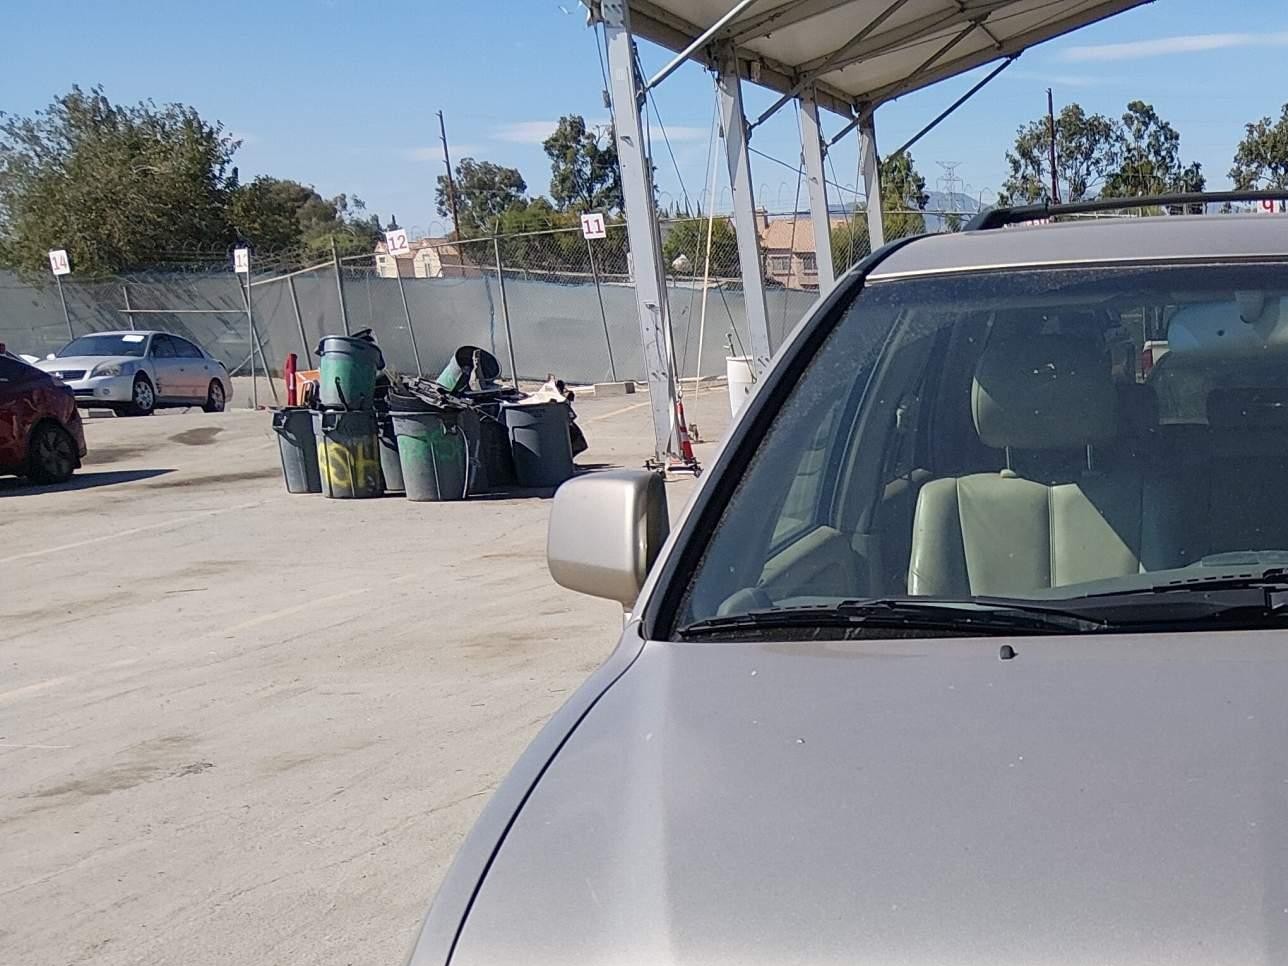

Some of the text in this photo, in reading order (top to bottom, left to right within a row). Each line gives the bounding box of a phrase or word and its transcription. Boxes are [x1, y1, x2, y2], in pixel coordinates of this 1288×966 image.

[583, 219, 604, 235] 11
[388, 234, 408, 251] 12
[52, 256, 67, 270] 14
